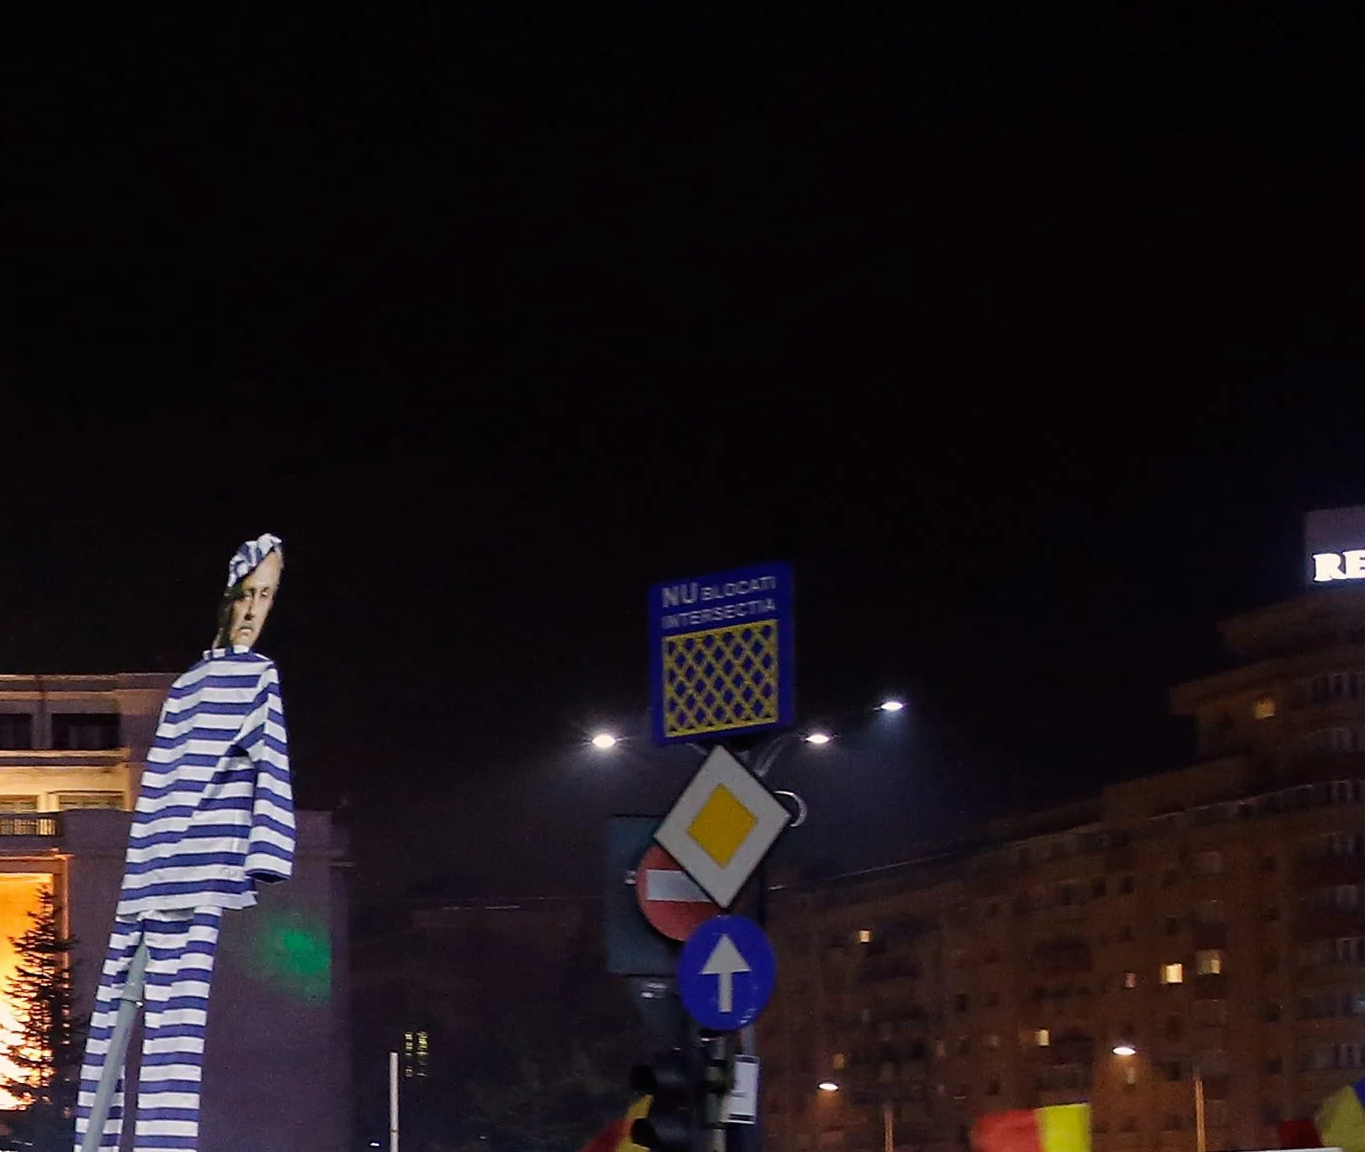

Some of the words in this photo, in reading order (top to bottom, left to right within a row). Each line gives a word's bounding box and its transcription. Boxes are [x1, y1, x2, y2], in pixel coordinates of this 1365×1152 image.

[662, 582, 699, 608] NU
[700, 576, 777, 601] BLOCATI
[661, 598, 777, 630] INTERSECTIA
